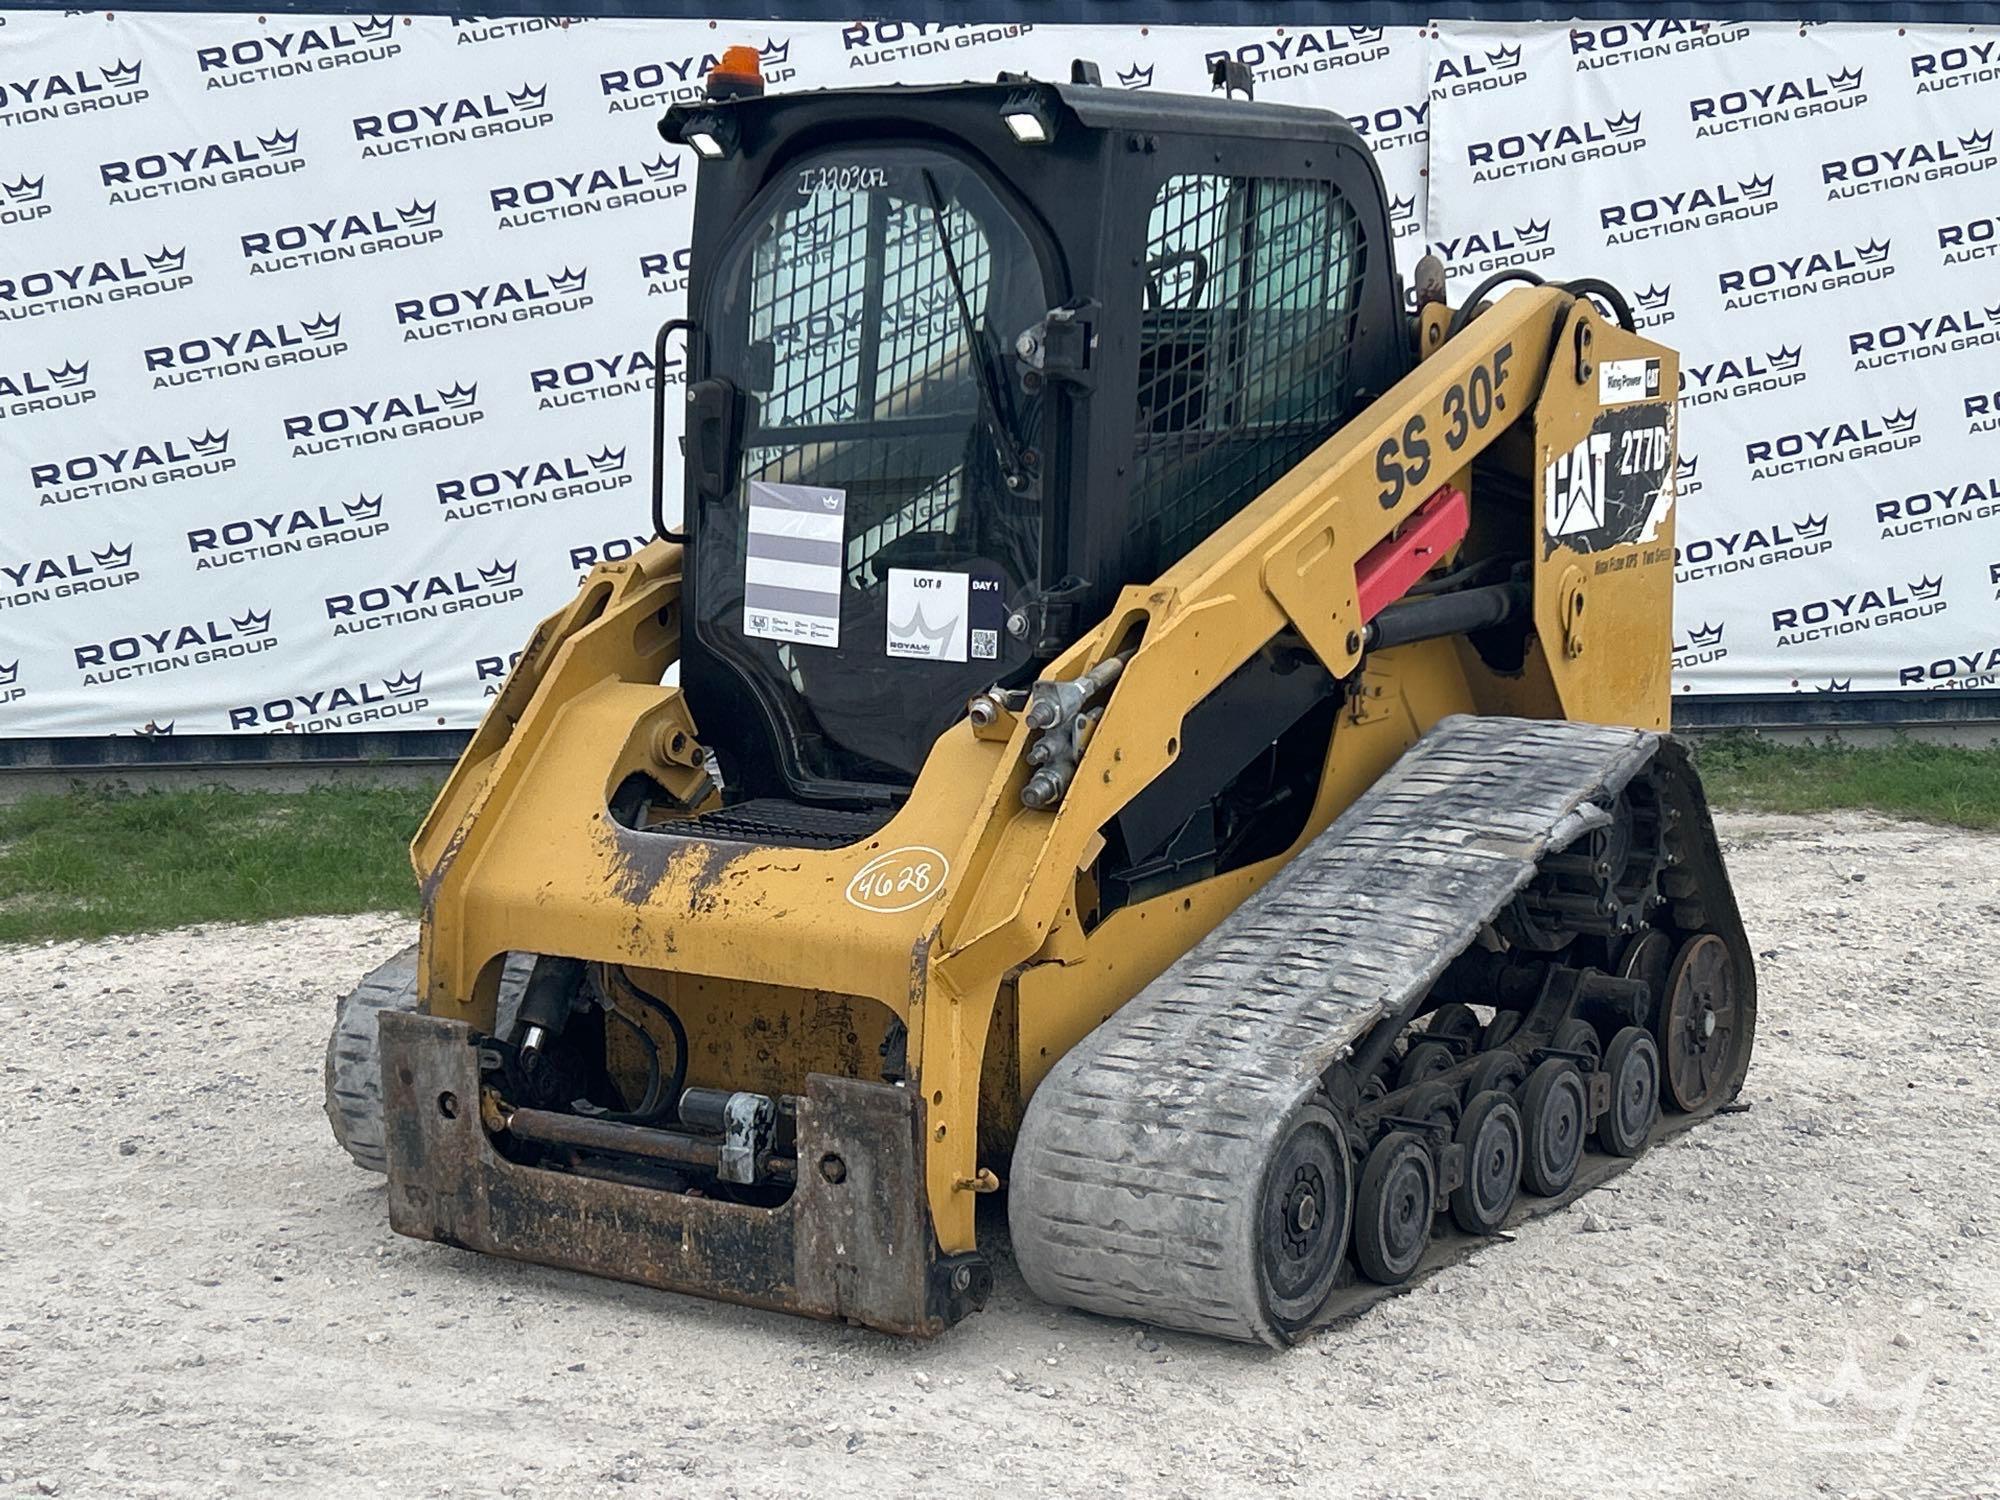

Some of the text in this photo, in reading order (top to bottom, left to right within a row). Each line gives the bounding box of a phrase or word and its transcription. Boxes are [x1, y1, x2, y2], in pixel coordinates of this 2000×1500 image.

[196, 25, 356, 72] ROYAL
[206, 44, 401, 91] AUCTION GROUP
[849, 38, 950, 69] AUCTION
[1252, 46, 1390, 84] TION GROUP
[1576, 28, 1750, 72] AUCTION GROUP
[1911, 41, 2000, 78] ROY
[0, 71, 103, 108] YAL
[600, 54, 721, 96] ROYA
[1452, 72, 1527, 97] GROUP
[0, 90, 149, 127] TION GROUP
[352, 95, 509, 141] ROYAL
[1347, 101, 1429, 135] ROY
[1690, 77, 1828, 122] ROYAL
[1696, 94, 1868, 139] AUCTION GROUP
[362, 113, 553, 159] AUCTION GROUP
[1467, 122, 1606, 167] ROYAL
[99, 140, 260, 187] ROYAL
[109, 158, 306, 205] AUCTION GROUP
[1473, 138, 1646, 184] AUCTION GROUP
[1821, 140, 1959, 184] ROYAL
[1827, 157, 1998, 201] AUCTION GROUP
[490, 165, 643, 212] ROYAL
[498, 184, 687, 230] AUCTION GROUP
[1600, 185, 1739, 230] ROYAL
[0, 205, 52, 224] OUP
[240, 211, 398, 258] ROYAL
[1606, 201, 1778, 247] AUCTION GROUP
[249, 229, 443, 276] AUCTION GROUP
[1426, 230, 1515, 261] YAL
[1479, 247, 1555, 272] GROUP
[1943, 244, 2000, 266] AUCT
[0, 258, 147, 301] ROYAL
[1719, 249, 1856, 295] ROYAL
[1724, 266, 1895, 311] AUCTION GROUP
[0, 275, 193, 321] AUCTION GROUP
[395, 278, 550, 325] ROYAL
[404, 296, 594, 343] AUCTION GROUP
[1633, 311, 1675, 329] OUP
[144, 324, 303, 372] ROYAL
[1849, 310, 1985, 355] ROYAL
[1854, 331, 2000, 372] AUCTION GRO
[153, 342, 348, 390] AUCTION GROUP
[1679, 355, 1767, 391] YAL
[11, 390, 96, 416] GROUP
[538, 380, 641, 411] AUCTION
[1679, 372, 1806, 408] TION GROUP
[283, 393, 440, 440] ROYAL
[292, 410, 484, 458] AUCTION GROUP
[1376, 414, 1431, 510] SS
[1620, 426, 1665, 476] 277D
[1746, 419, 1883, 464] ROYAL
[1751, 435, 1921, 481] AUCTION GROUP
[30, 441, 191, 489] ROYAL
[40, 458, 236, 507] AUCTION GROUP
[436, 457, 589, 505] ROYAL
[1545, 432, 1611, 537] CAT
[444, 474, 632, 522] AUCTION GROUP
[187, 506, 345, 553] ROYAL
[196, 522, 390, 571] AUCTION GROUP
[1881, 510, 1972, 540] AUCTION
[0, 554, 94, 587] YAL
[913, 577, 933, 589] LOT
[1674, 540, 1832, 583] UCTION GROUP
[55, 571, 140, 598] GROUP
[325, 572, 480, 620] ROYAL
[972, 581, 999, 591] DAY 1
[333, 588, 524, 637] AUCTION GROUP
[1772, 586, 1909, 632] ROYAL
[1776, 601, 1947, 648] AUCTION GROUP
[74, 621, 233, 670] ROYAL
[83, 637, 278, 687] AUCTION GROUP
[1671, 648, 1728, 669] ROUP
[228, 683, 386, 731] ROYAL
[347, 698, 429, 725] GROUP
[859, 863, 931, 900] 4628
